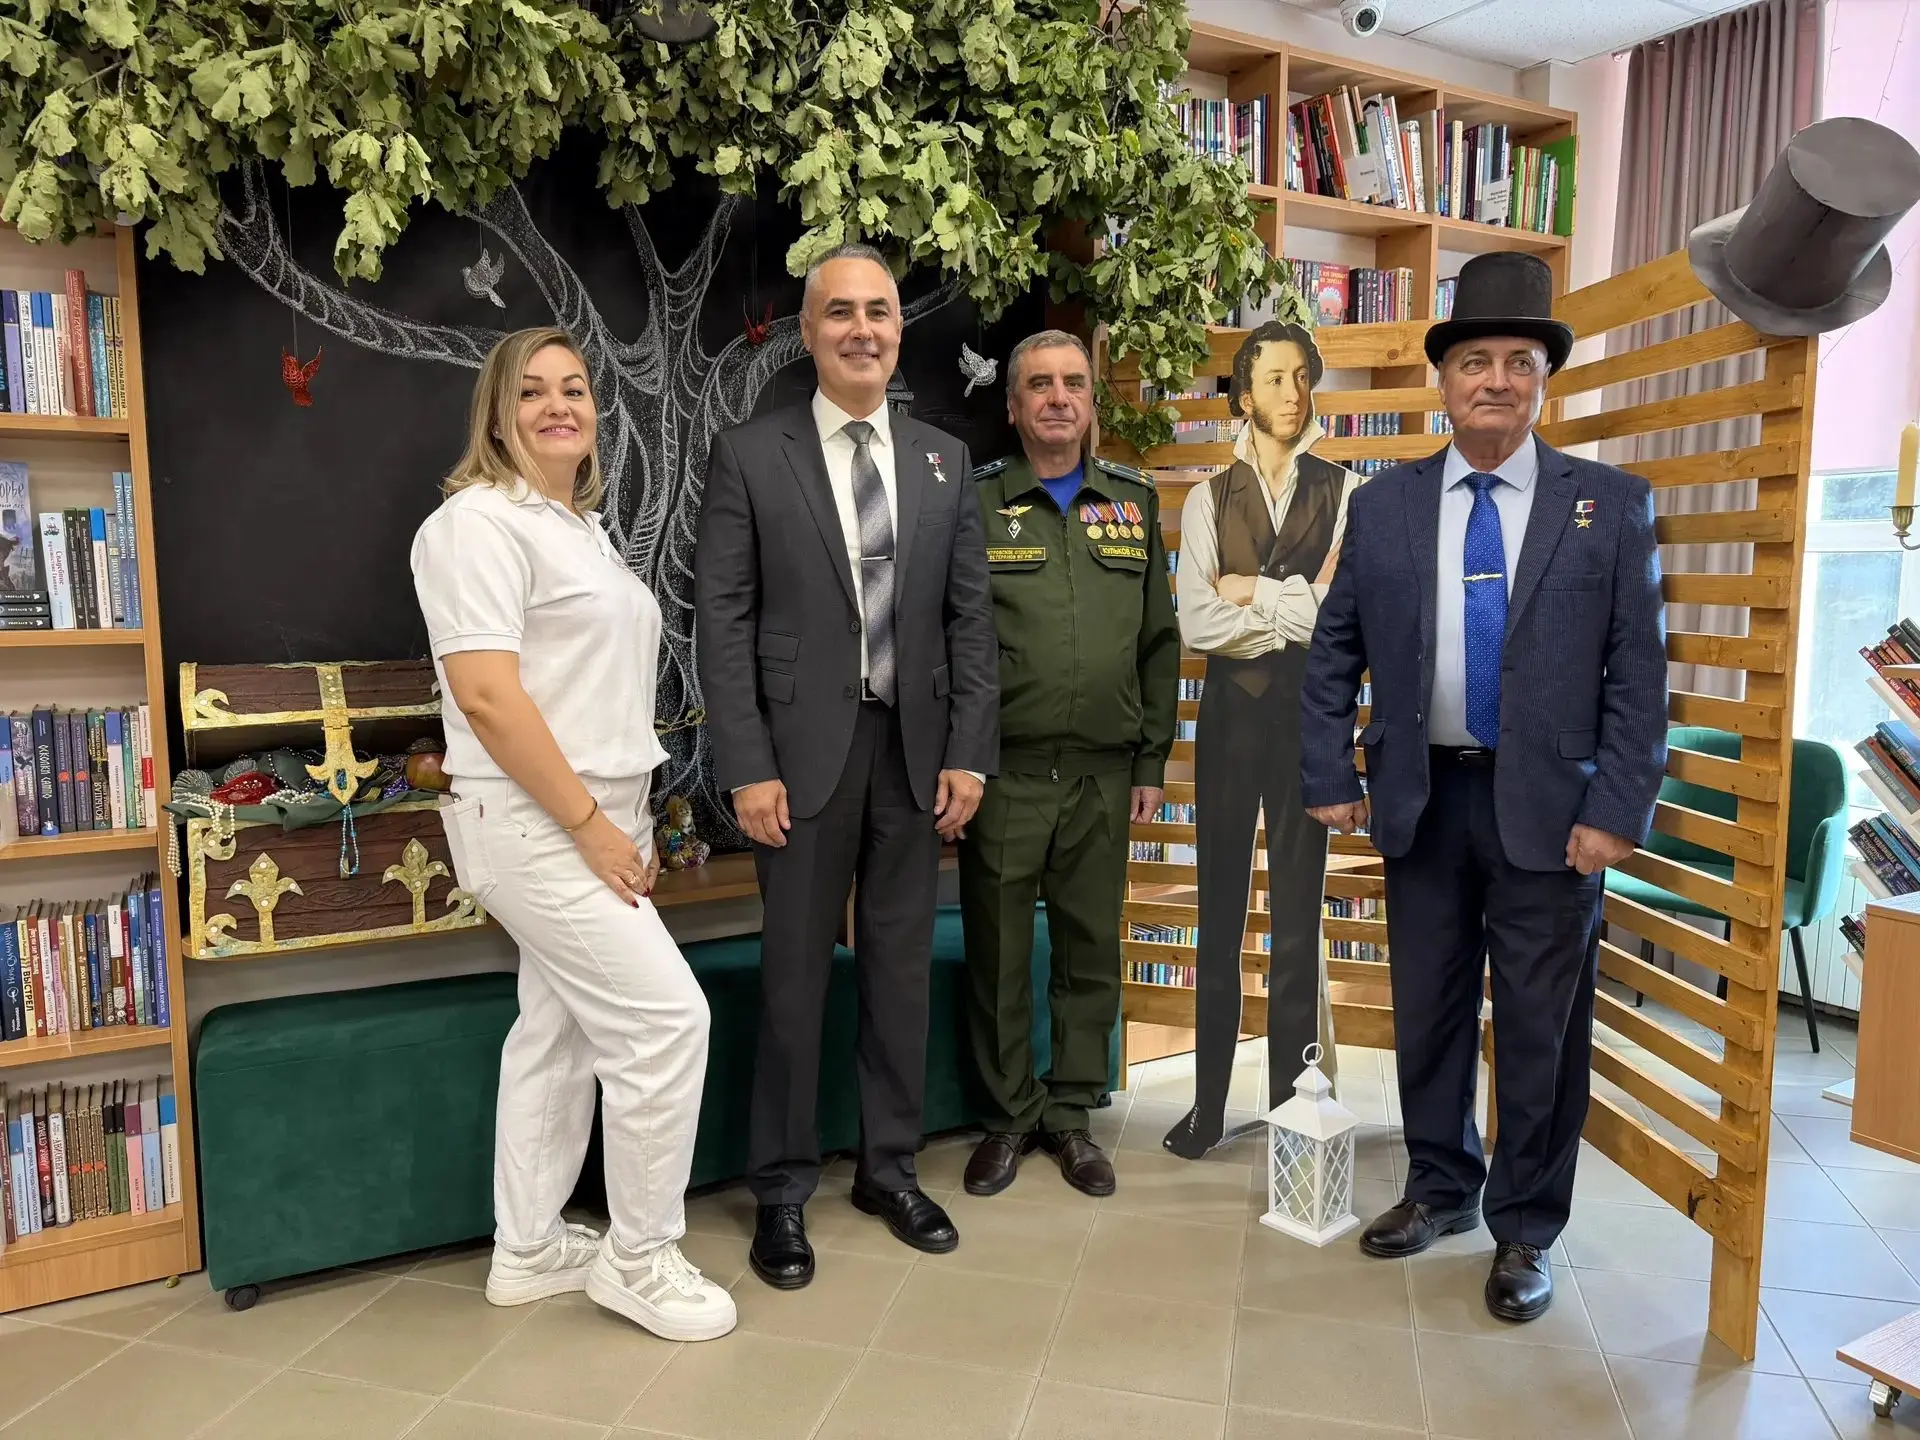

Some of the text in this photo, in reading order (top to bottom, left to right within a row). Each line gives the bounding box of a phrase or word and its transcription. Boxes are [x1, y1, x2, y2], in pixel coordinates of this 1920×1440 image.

[74, 316, 82, 338] 2021
[108, 349, 116, 379] РАССКАЗЫ
[117, 349, 125, 379] РАССКАЗЫ
[55, 550, 65, 586] Свадебное
[1102, 547, 1131, 556] КУЛЬКОВ
[111, 558, 122, 616] ЮРИЙ КАЗАКОВ
[38, 745, 53, 799] ОСКОЛКИ САМПО
[93, 781, 104, 820] БОЛЬШАЯ
[23, 971, 34, 1012] ВЫСТРЕЛ
[81, 987, 89, 1026] ОДНОКЛАССНИКОВ
